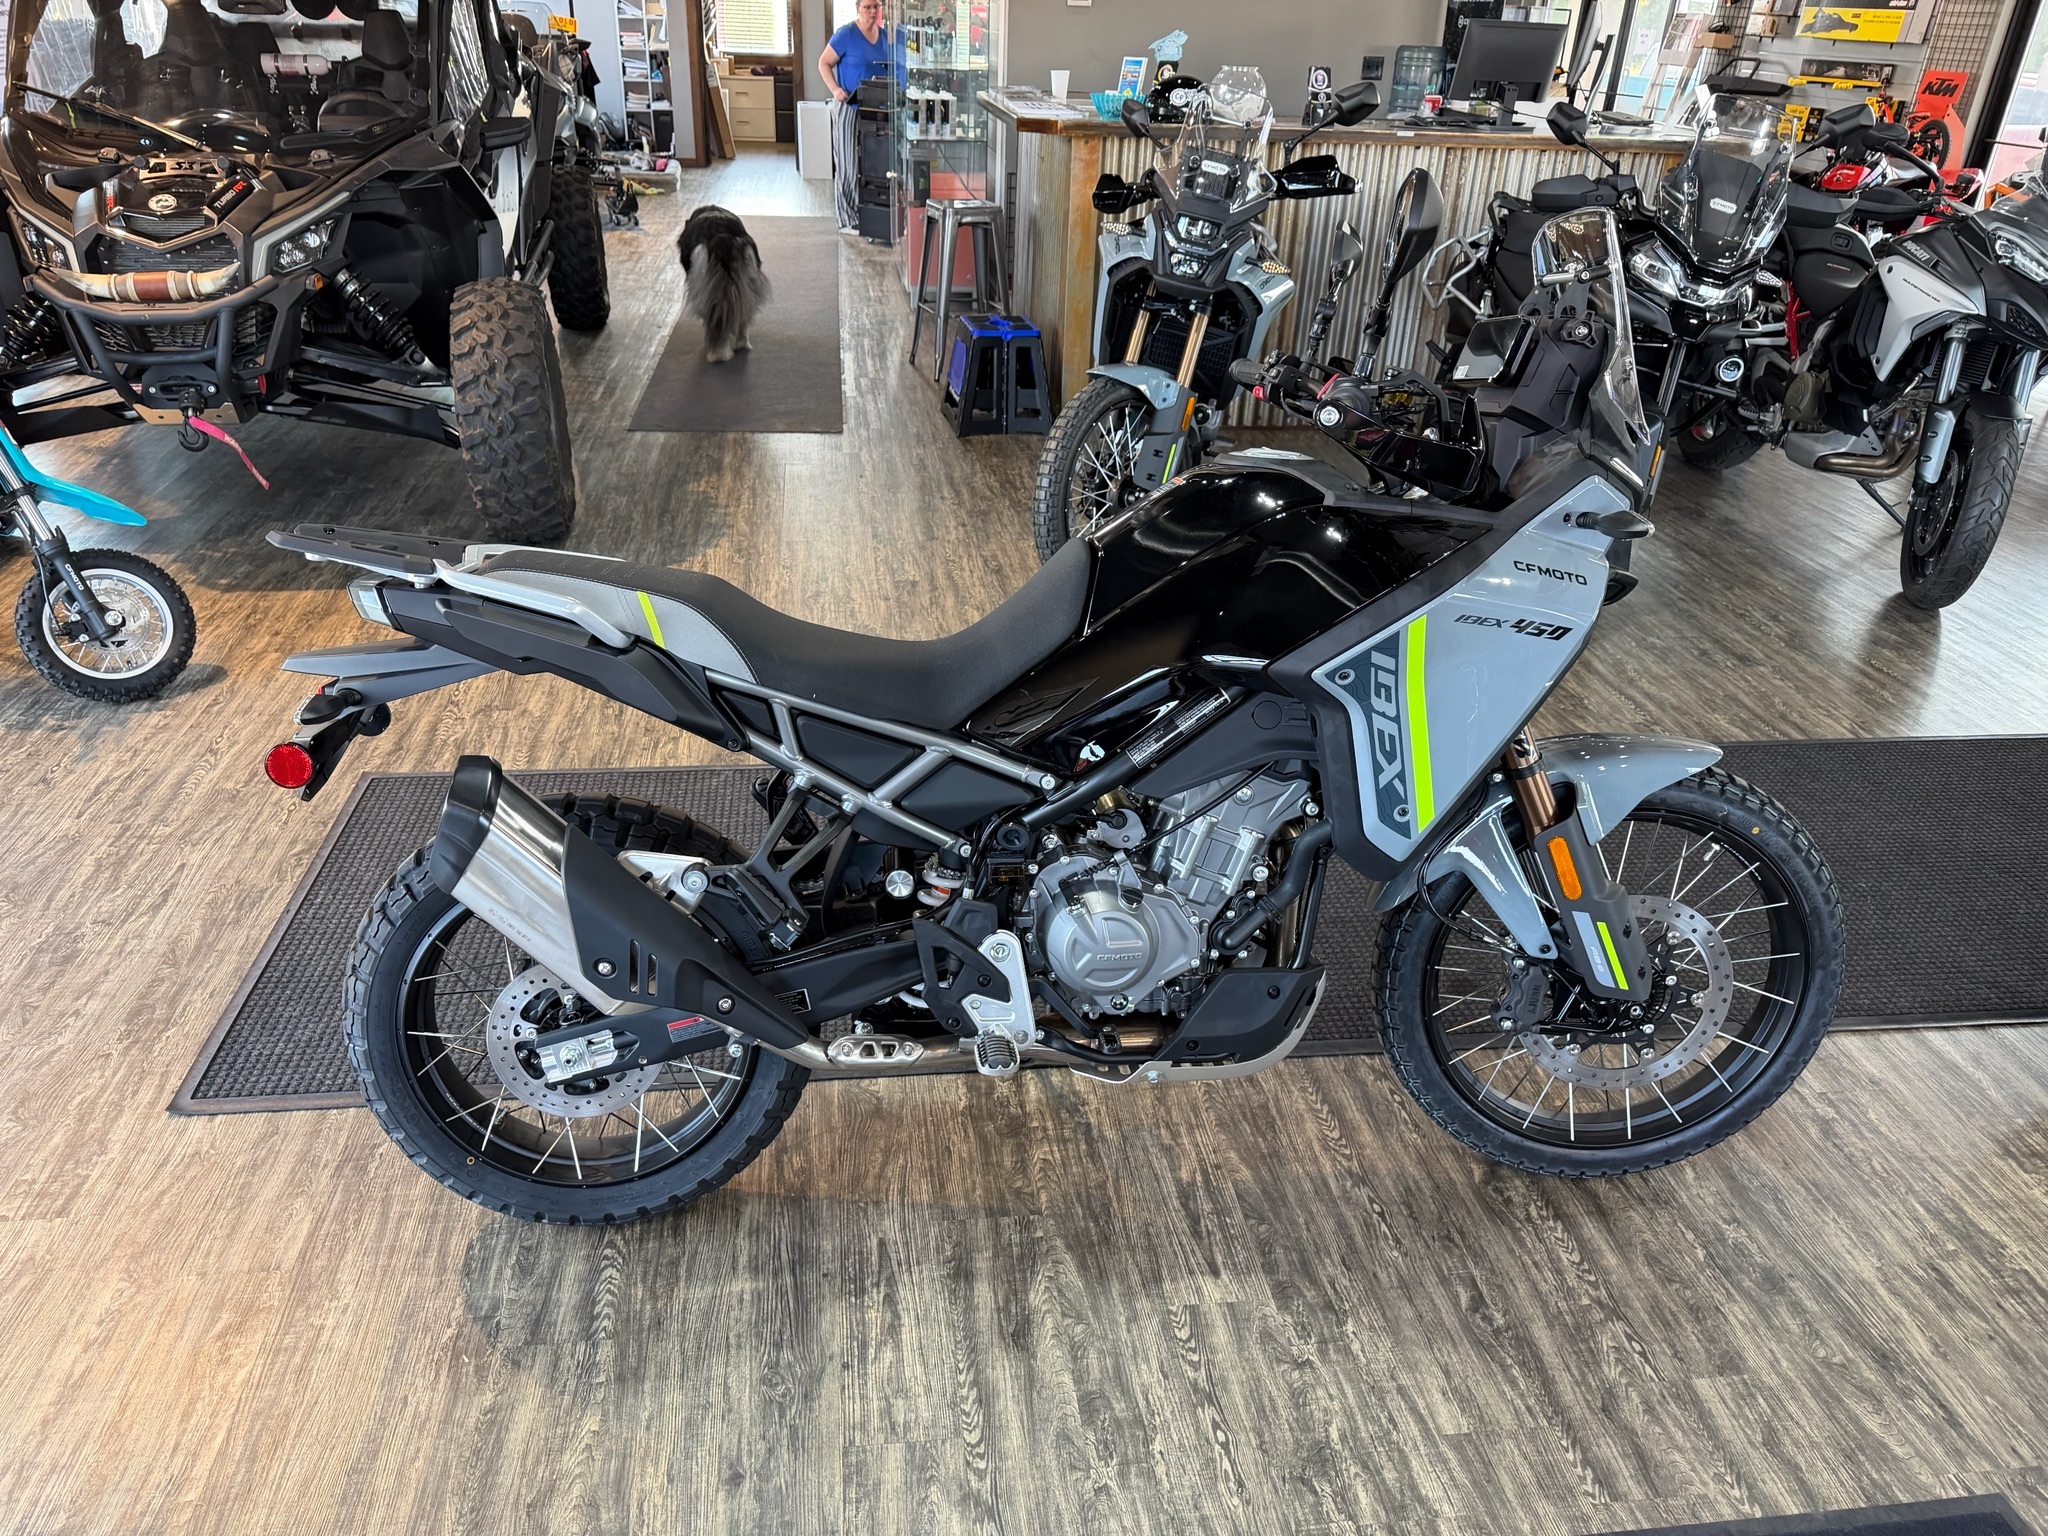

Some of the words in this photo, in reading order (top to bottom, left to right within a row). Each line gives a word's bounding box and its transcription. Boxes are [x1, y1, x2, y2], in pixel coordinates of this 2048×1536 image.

[1921, 77, 1960, 98] KTM
[213, 188, 236, 209] TURBO
[1902, 240, 1931, 262] DUCATI
[64, 563, 85, 591] CFMOTO
[1513, 560, 1588, 586] CFMOTO
[1453, 614, 1511, 629] IBEX
[1509, 618, 1574, 641] 450
[1371, 650, 1406, 800] IBEX
[1096, 951, 1143, 962] CFMOTO
[1590, 946, 1605, 973] ABS
